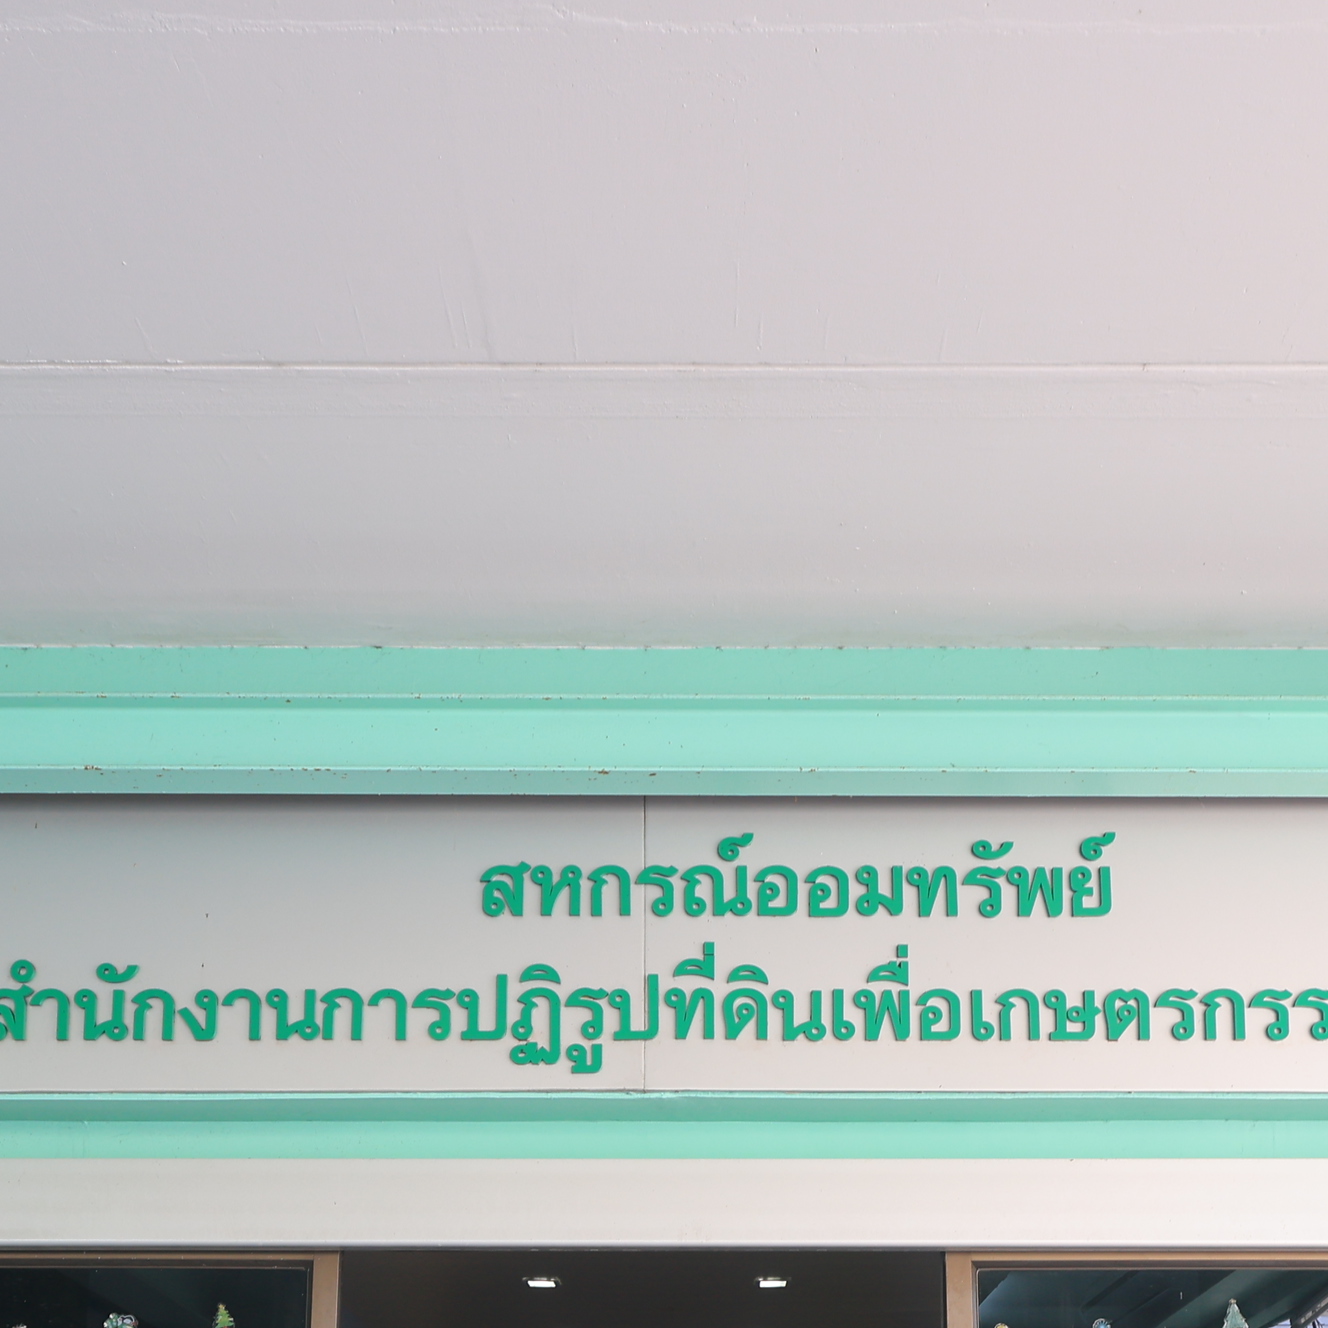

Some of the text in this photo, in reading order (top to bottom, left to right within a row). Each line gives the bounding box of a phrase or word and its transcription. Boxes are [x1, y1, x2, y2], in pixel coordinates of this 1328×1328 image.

[479, 831, 1116, 918] สหกรณ์ออมทรัพย์
